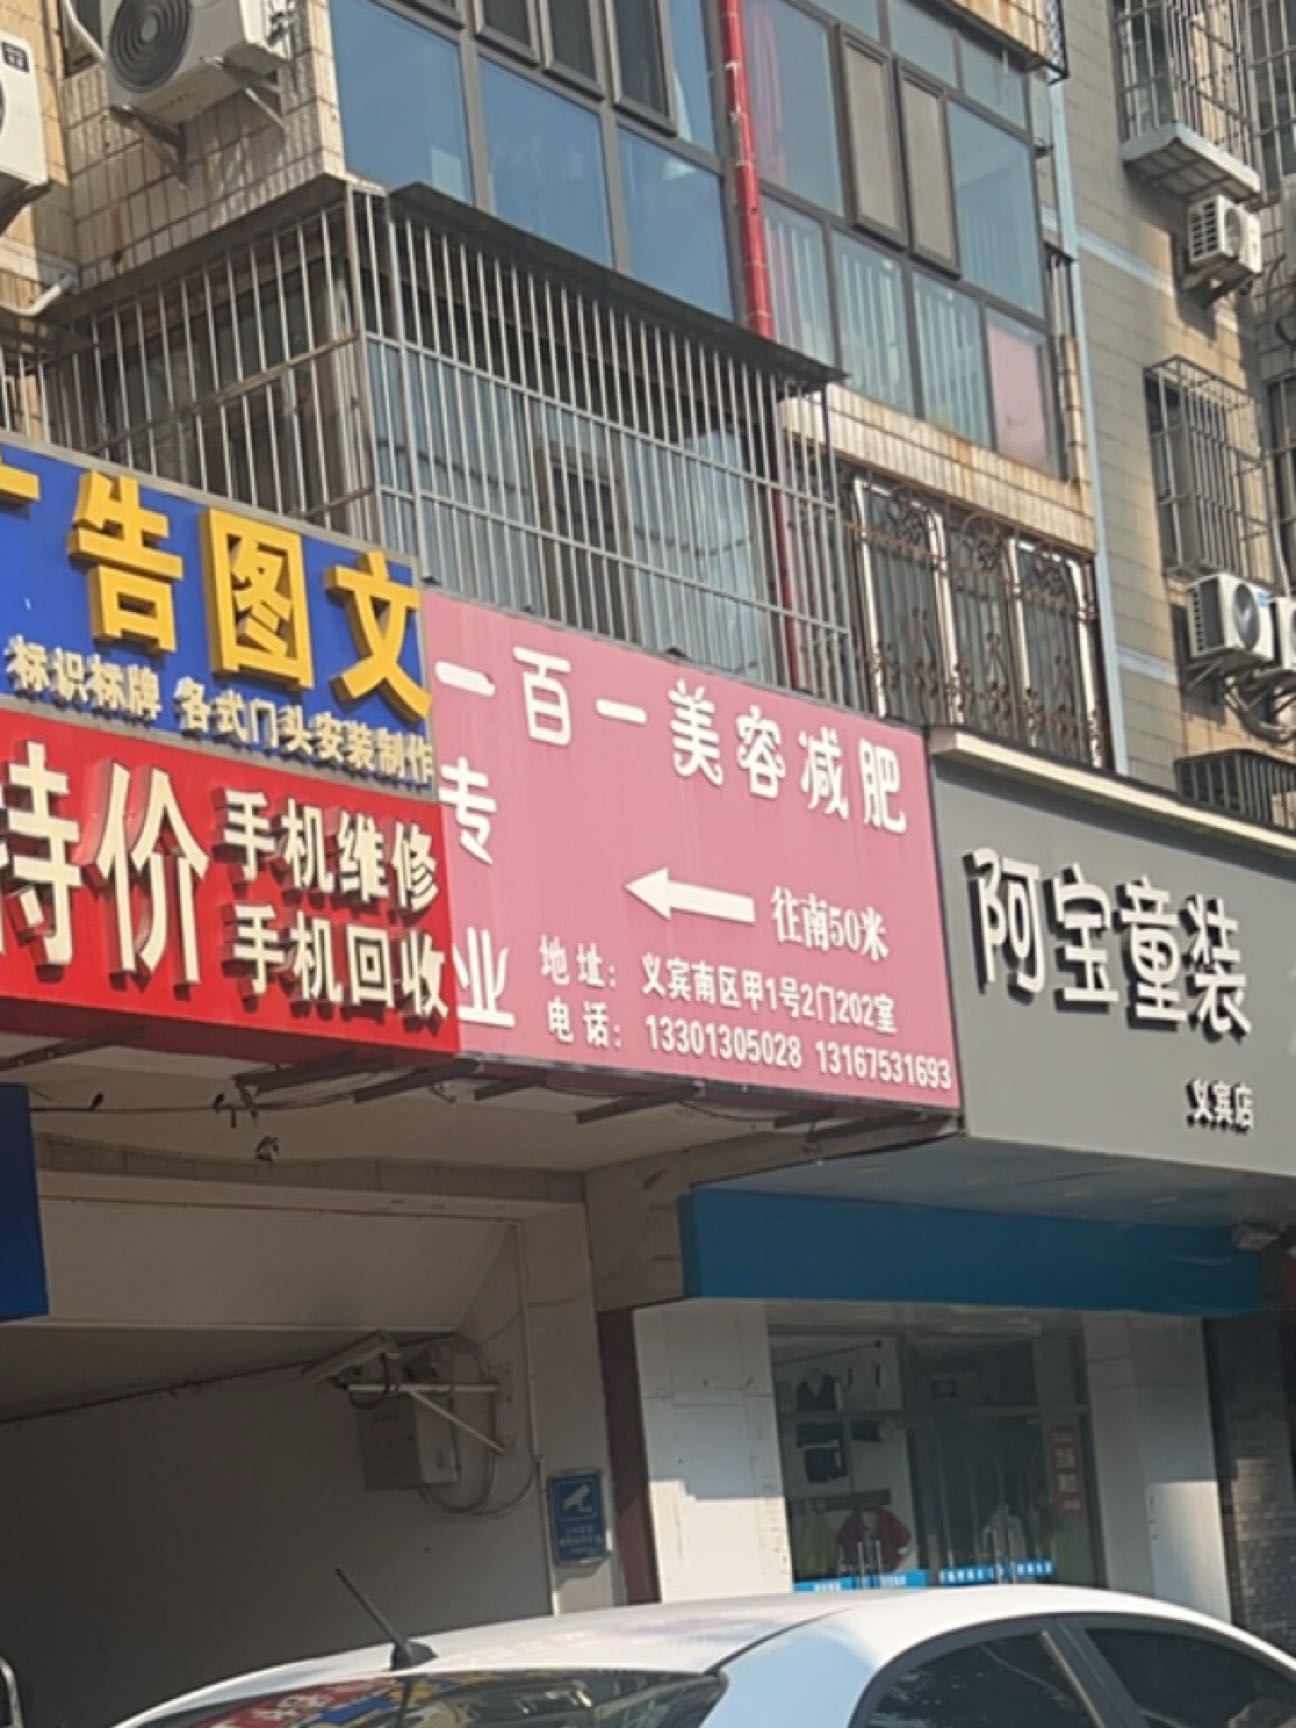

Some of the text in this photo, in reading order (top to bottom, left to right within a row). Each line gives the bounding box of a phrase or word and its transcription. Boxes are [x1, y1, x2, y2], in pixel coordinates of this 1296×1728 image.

[5, 635, 162, 721] 标识标牌
[174, 676, 433, 785] 各式门头安装制作
[435, 646, 907, 834] 一百一美容减肥
[217, 788, 440, 912] 手机维修
[225, 903, 447, 1020] 手机回收
[964, 847, 1254, 1036] 阿宝童装
[645, 1014, 803, 1069] 13301305028
[814, 1040, 953, 1091] 13167531693
[1188, 1079, 1254, 1132] 义宾店
